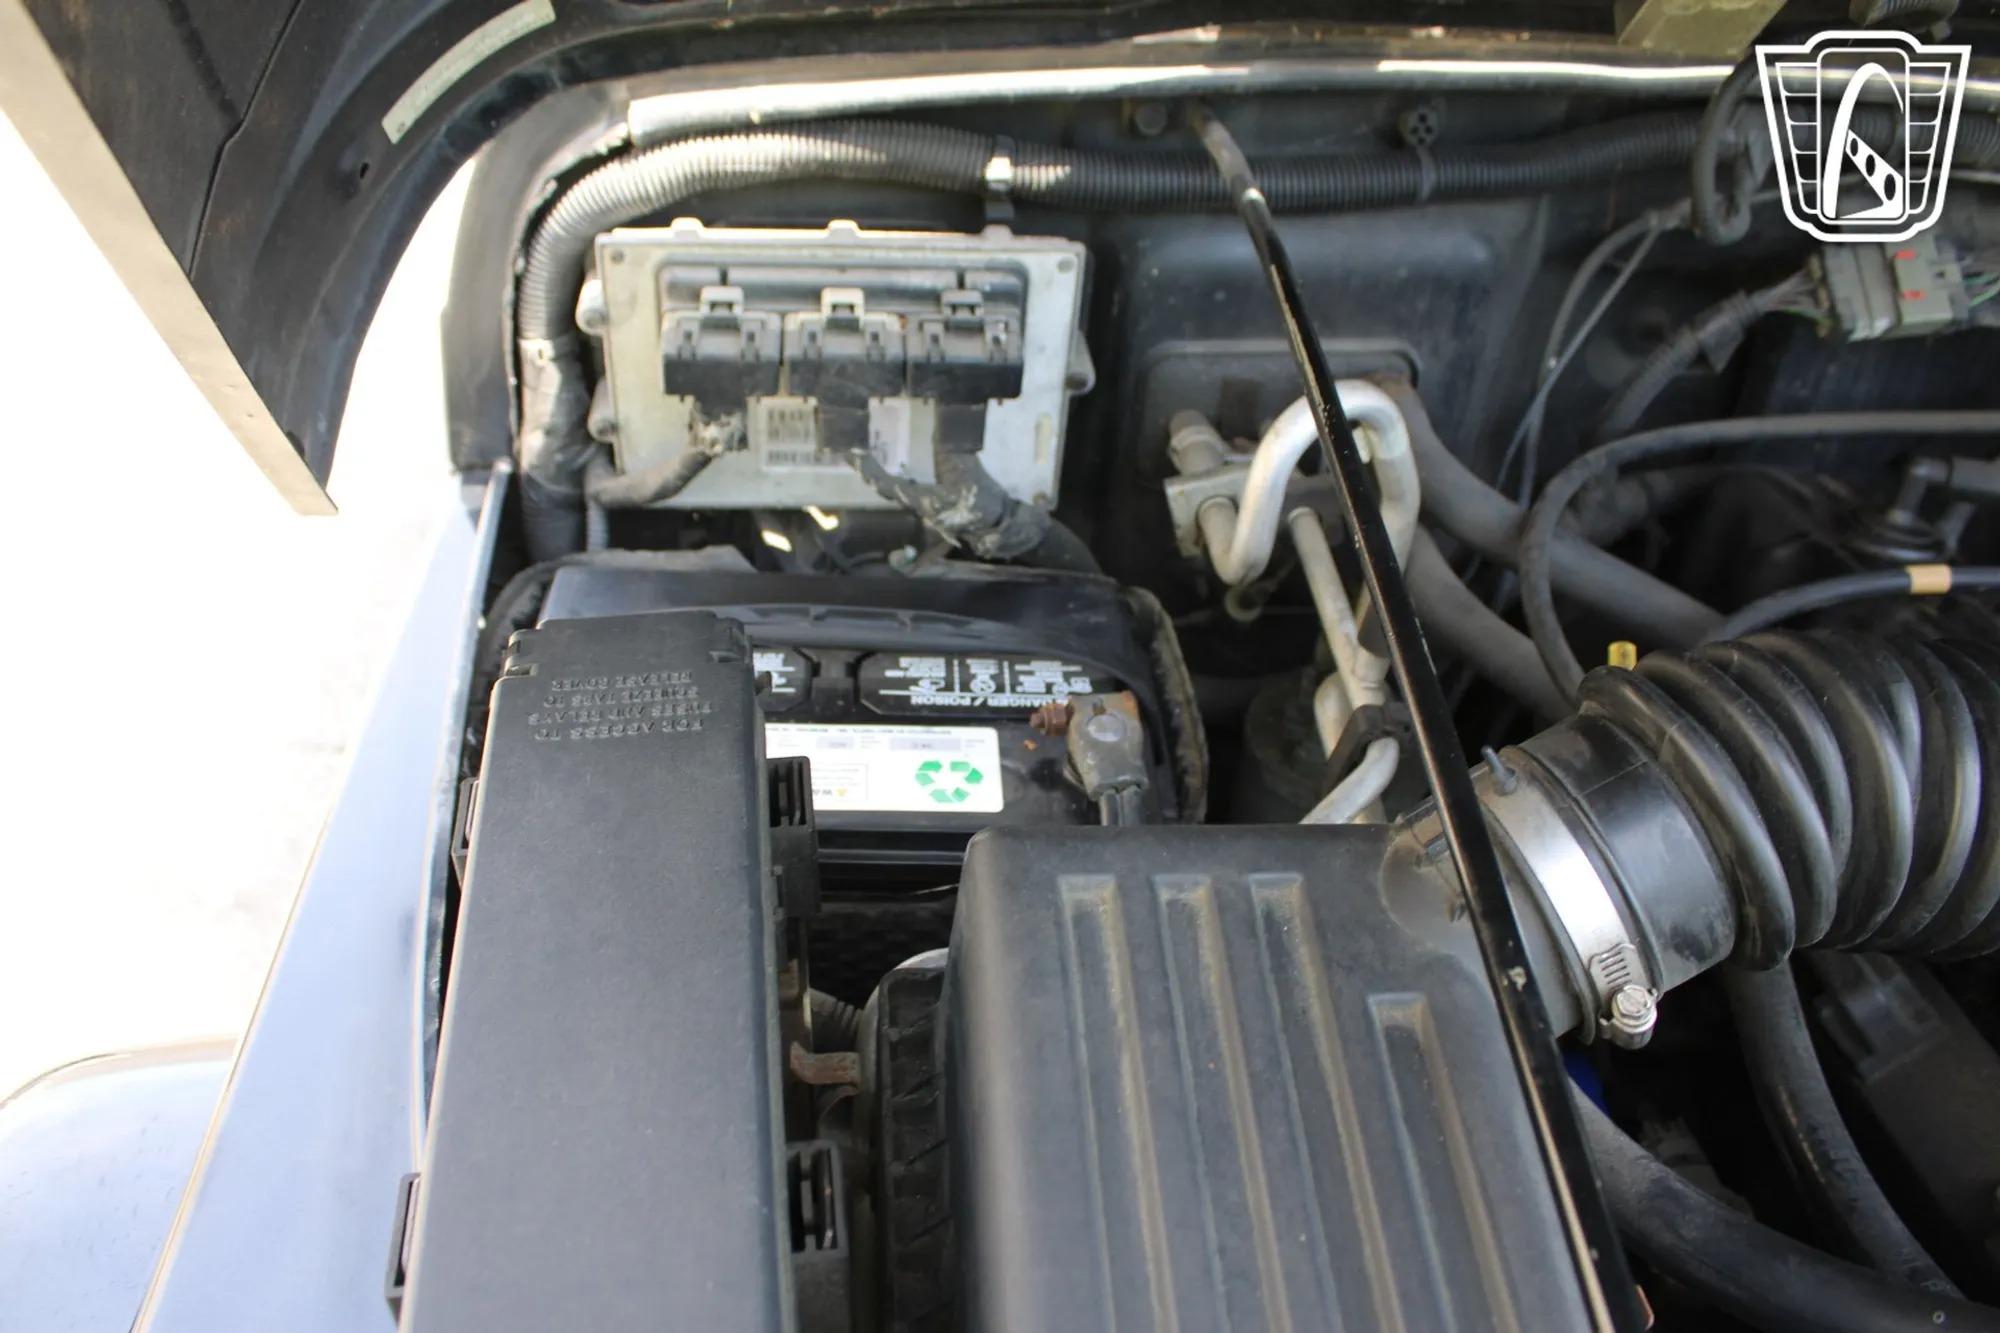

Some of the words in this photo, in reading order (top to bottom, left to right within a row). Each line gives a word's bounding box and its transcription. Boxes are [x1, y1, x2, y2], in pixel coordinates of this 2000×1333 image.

[552, 677, 610, 691] COVER
[615, 671, 692, 688] RELEASE
[571, 693, 616, 707] TABS
[621, 686, 698, 703] SQUEEZE
[910, 696, 971, 706] POISON
[543, 696, 564, 708] TO
[651, 701, 711, 717] FUSES
[528, 711, 601, 725] RELAYS
[608, 706, 645, 720] AND
[570, 722, 654, 739] ACCESS
[662, 719, 703, 732] FOR
[535, 729, 561, 741] TO
